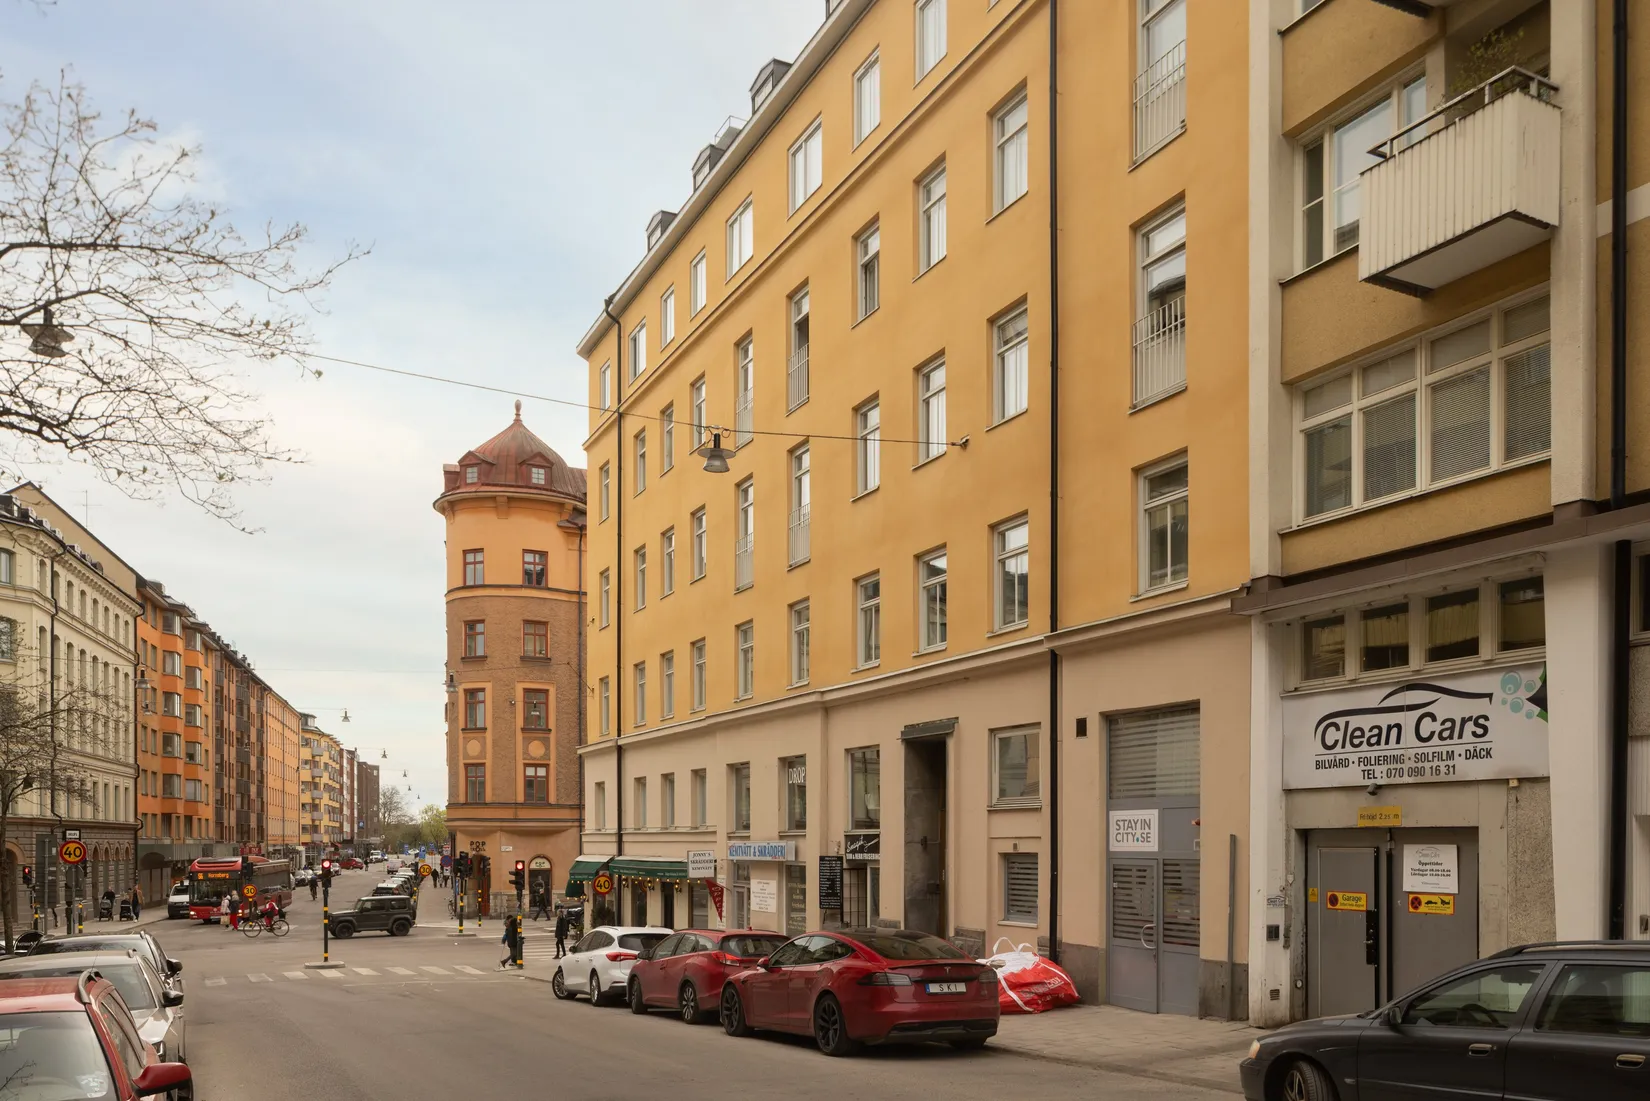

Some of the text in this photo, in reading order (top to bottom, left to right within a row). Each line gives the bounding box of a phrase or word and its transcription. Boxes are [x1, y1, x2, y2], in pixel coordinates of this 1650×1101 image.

[1320, 711, 1490, 750] Clean Cars
[1315, 746, 1493, 770] BILVÅRD FOLIERING SOLFILM DÄCK
[789, 767, 805, 784] DROP
[1386, 767, 1404, 779] 070
[1407, 766, 1426, 778] 090
[1429, 765, 1441, 776] 16
[1444, 764, 1456, 775] 31
[1115, 818, 1151, 831] STAY IN
[63, 846, 83, 859] 40
[729, 843, 786, 857] KEMTVÄTT & SKRÄDDERI
[245, 887, 255, 895] 30
[596, 879, 610, 890] 40
[1342, 894, 1362, 903] Garage
